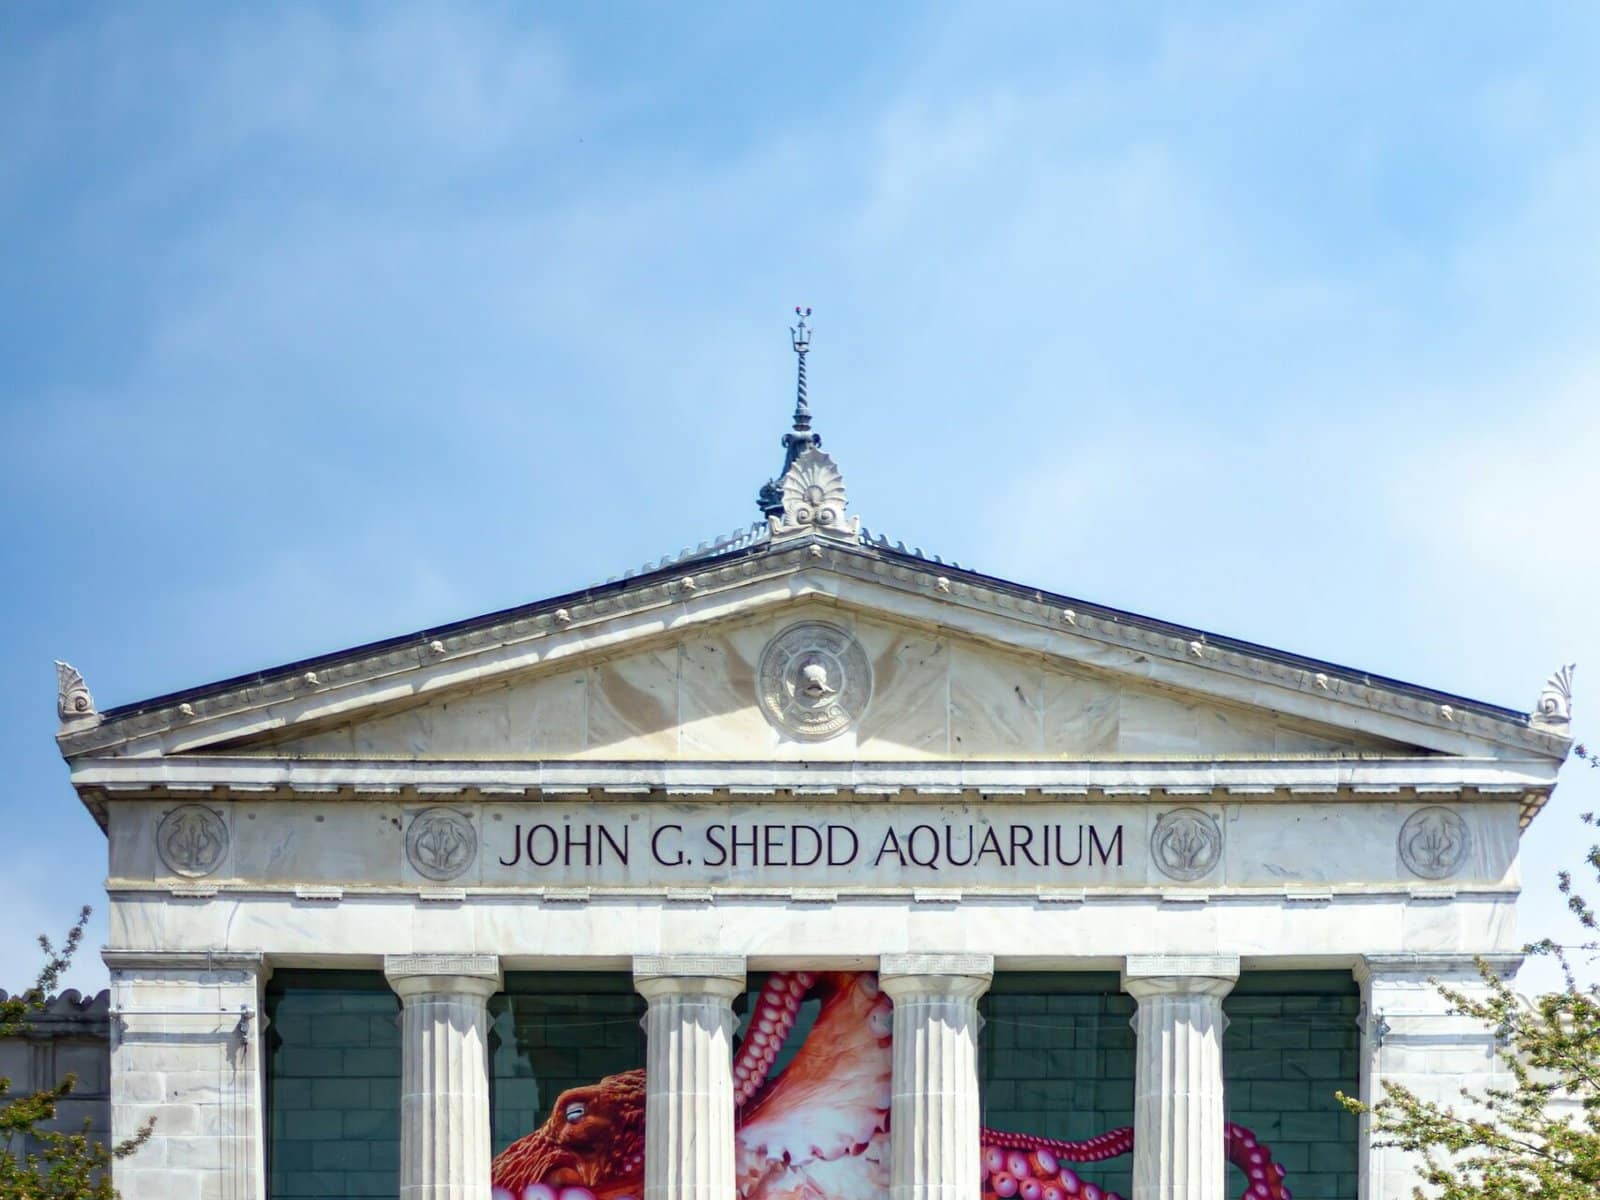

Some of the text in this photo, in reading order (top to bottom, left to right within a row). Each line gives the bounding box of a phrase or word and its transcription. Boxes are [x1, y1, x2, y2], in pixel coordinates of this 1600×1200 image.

[499, 824, 1123, 870] JOHN G. SHEDD AQUARIUM
